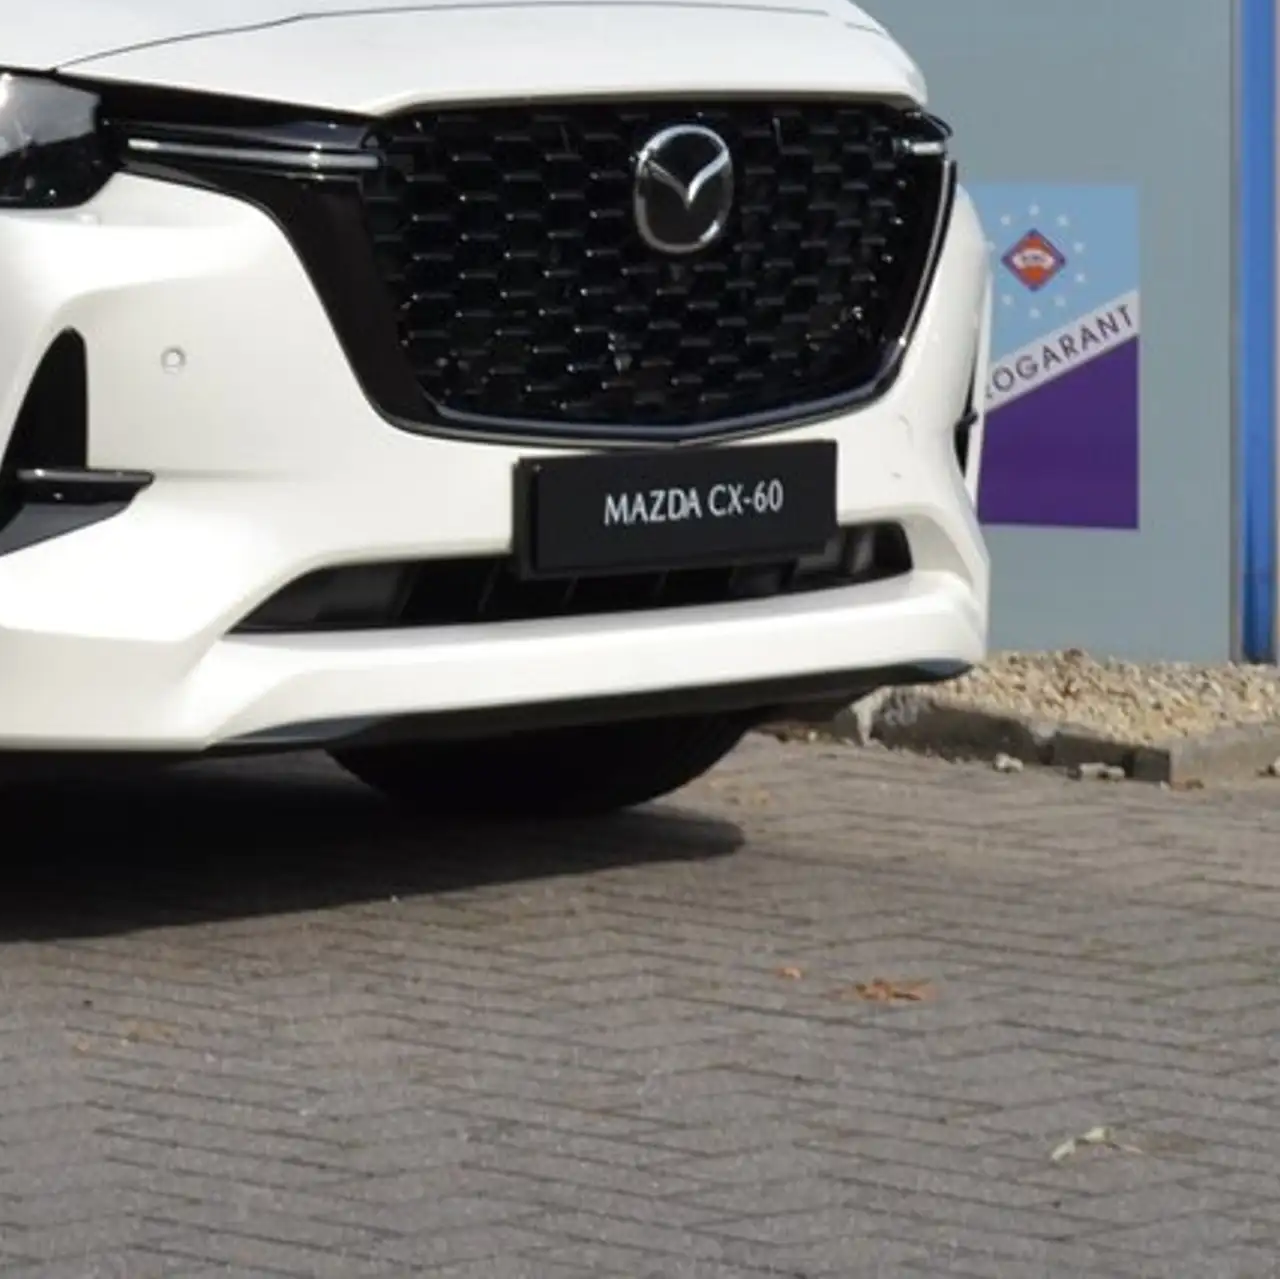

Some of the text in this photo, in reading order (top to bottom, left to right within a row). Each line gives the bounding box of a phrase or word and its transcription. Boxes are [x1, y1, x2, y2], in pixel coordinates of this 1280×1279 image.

[986, 304, 1134, 399] OGARANT
[604, 479, 784, 526] MAZDA CX-60
